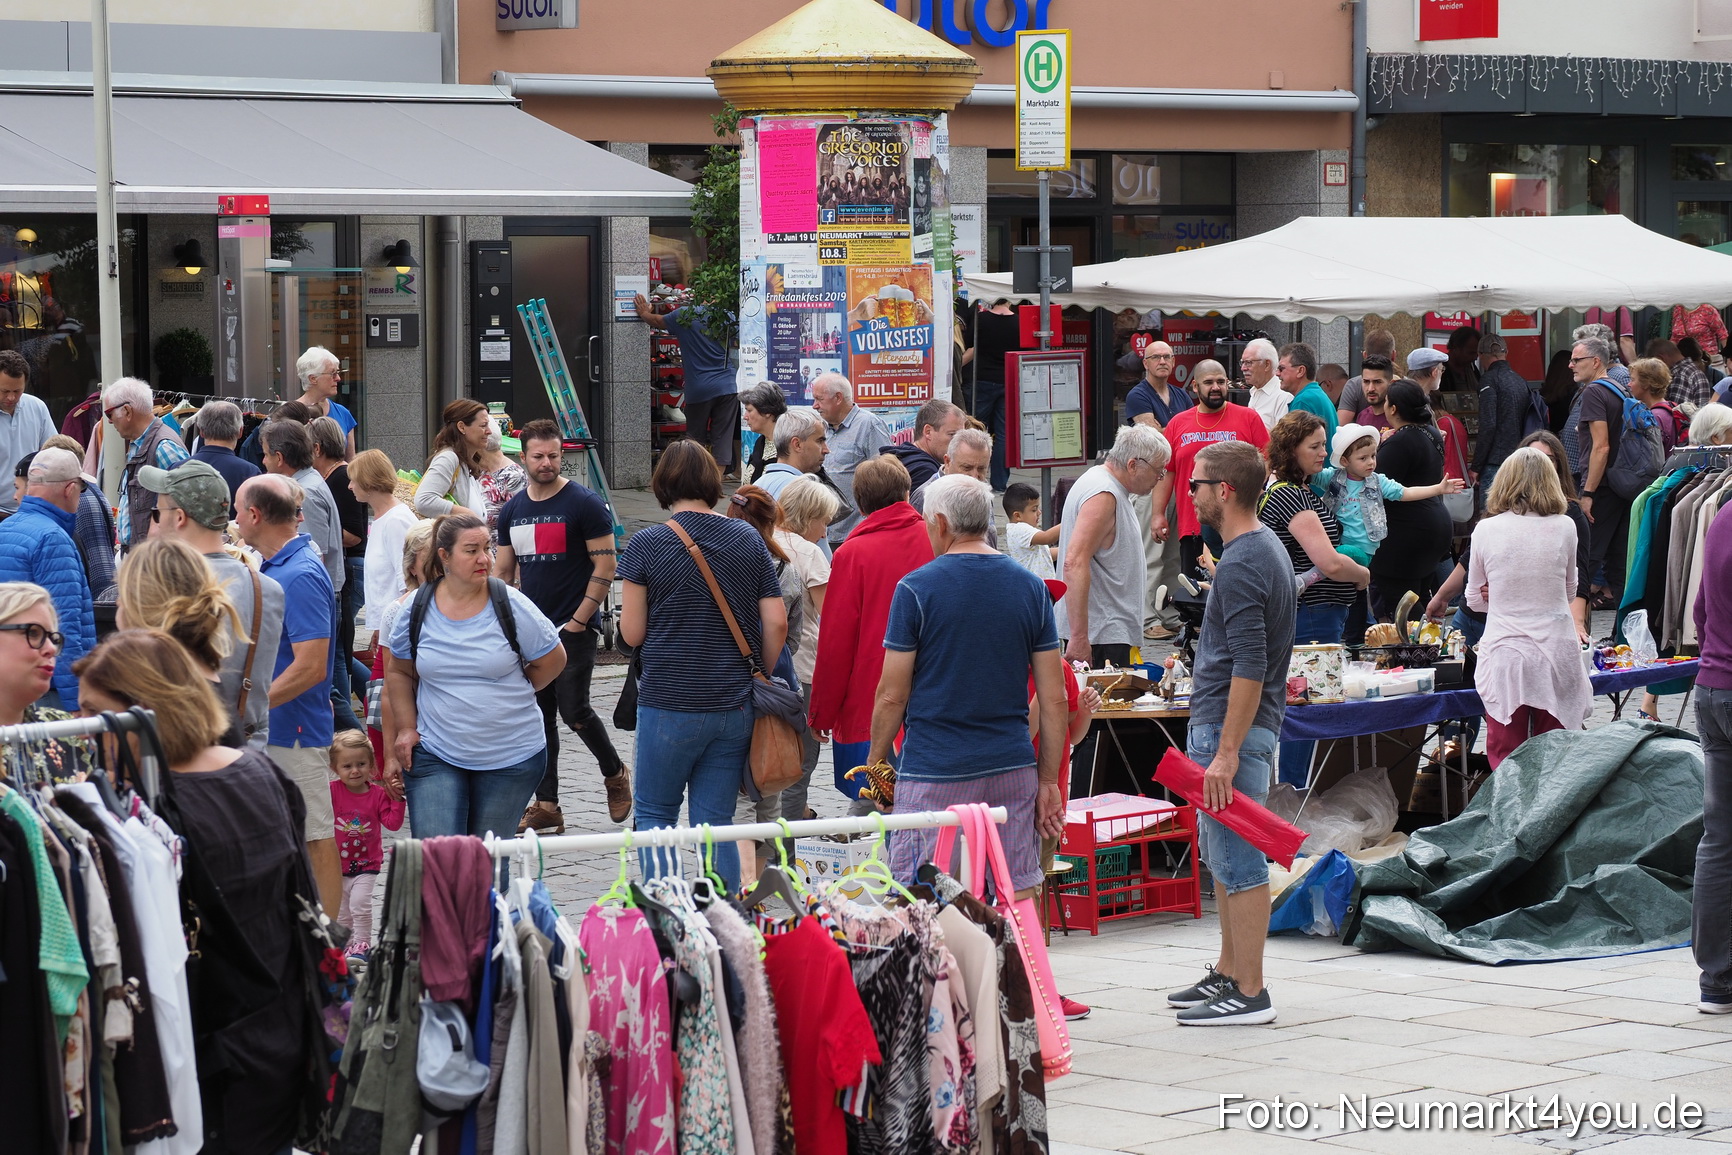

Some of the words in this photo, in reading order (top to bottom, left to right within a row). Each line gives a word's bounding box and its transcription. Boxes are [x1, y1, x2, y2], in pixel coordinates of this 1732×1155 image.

[1034, 52, 1053, 82] H
[1026, 99, 1060, 108] Marktplatz
[776, 233, 783, 242] 7.
[783, 233, 798, 241] Juni
[798, 232, 808, 241] 19
[821, 248, 842, 259] 10.8.
[766, 292, 823, 303] Erntedankfest
[824, 291, 847, 302] 2019
[869, 318, 888, 331] Die
[855, 327, 930, 352] VOLKSFEST
[1065, 334, 1088, 343] HABEN
[1173, 345, 1210, 357] EDUZIERT
[875, 350, 921, 367] Afterparty
[1180, 430, 1237, 447] SPALDING
[512, 516, 562, 526] TOMMY
[797, 844, 815, 852] BANANAS
[822, 847, 847, 855] GUATEMALA
